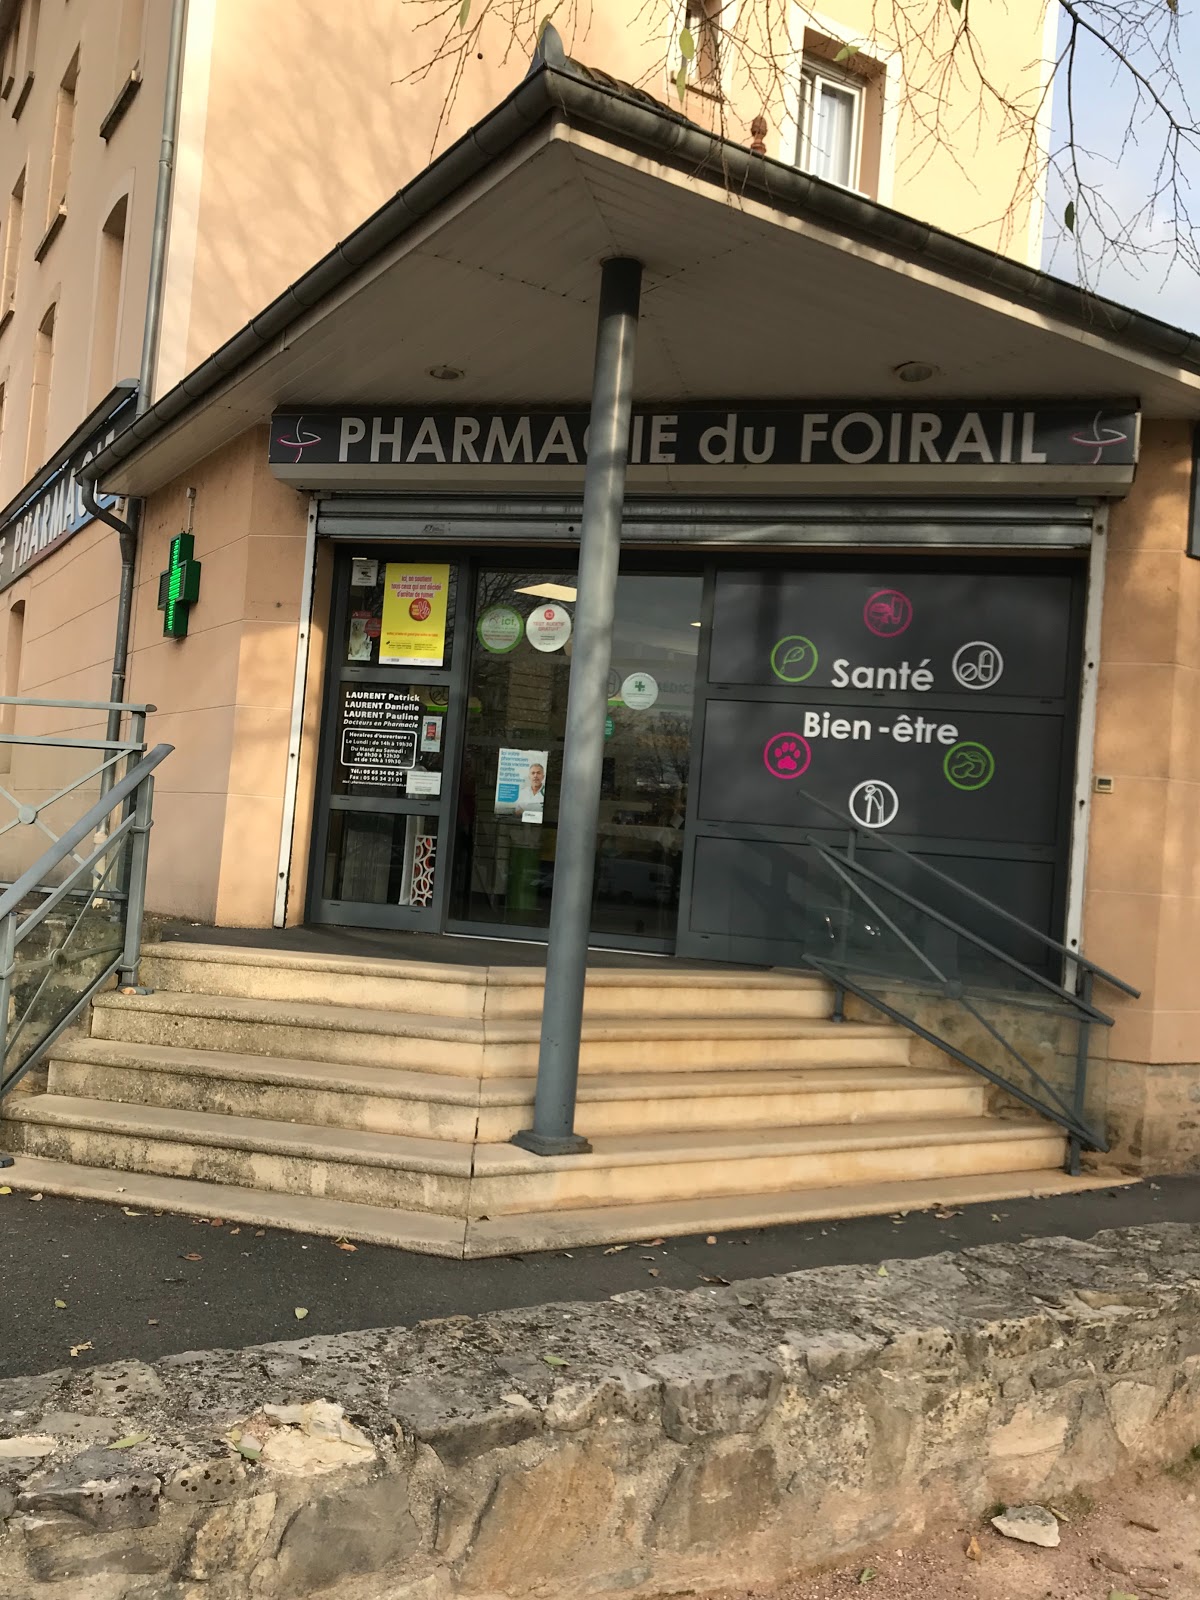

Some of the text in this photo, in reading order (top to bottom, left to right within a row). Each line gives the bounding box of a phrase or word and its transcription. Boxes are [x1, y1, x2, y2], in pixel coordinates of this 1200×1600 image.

[339, 411, 1047, 464] PHARMAIE du FOIRAIL
[831, 658, 934, 691] Santé
[345, 700, 420, 711] LAURENT Danielle
[346, 691, 420, 702] LAURENT Patrick
[344, 710, 419, 720] LAURENT Pauline
[803, 711, 872, 740] Bien
